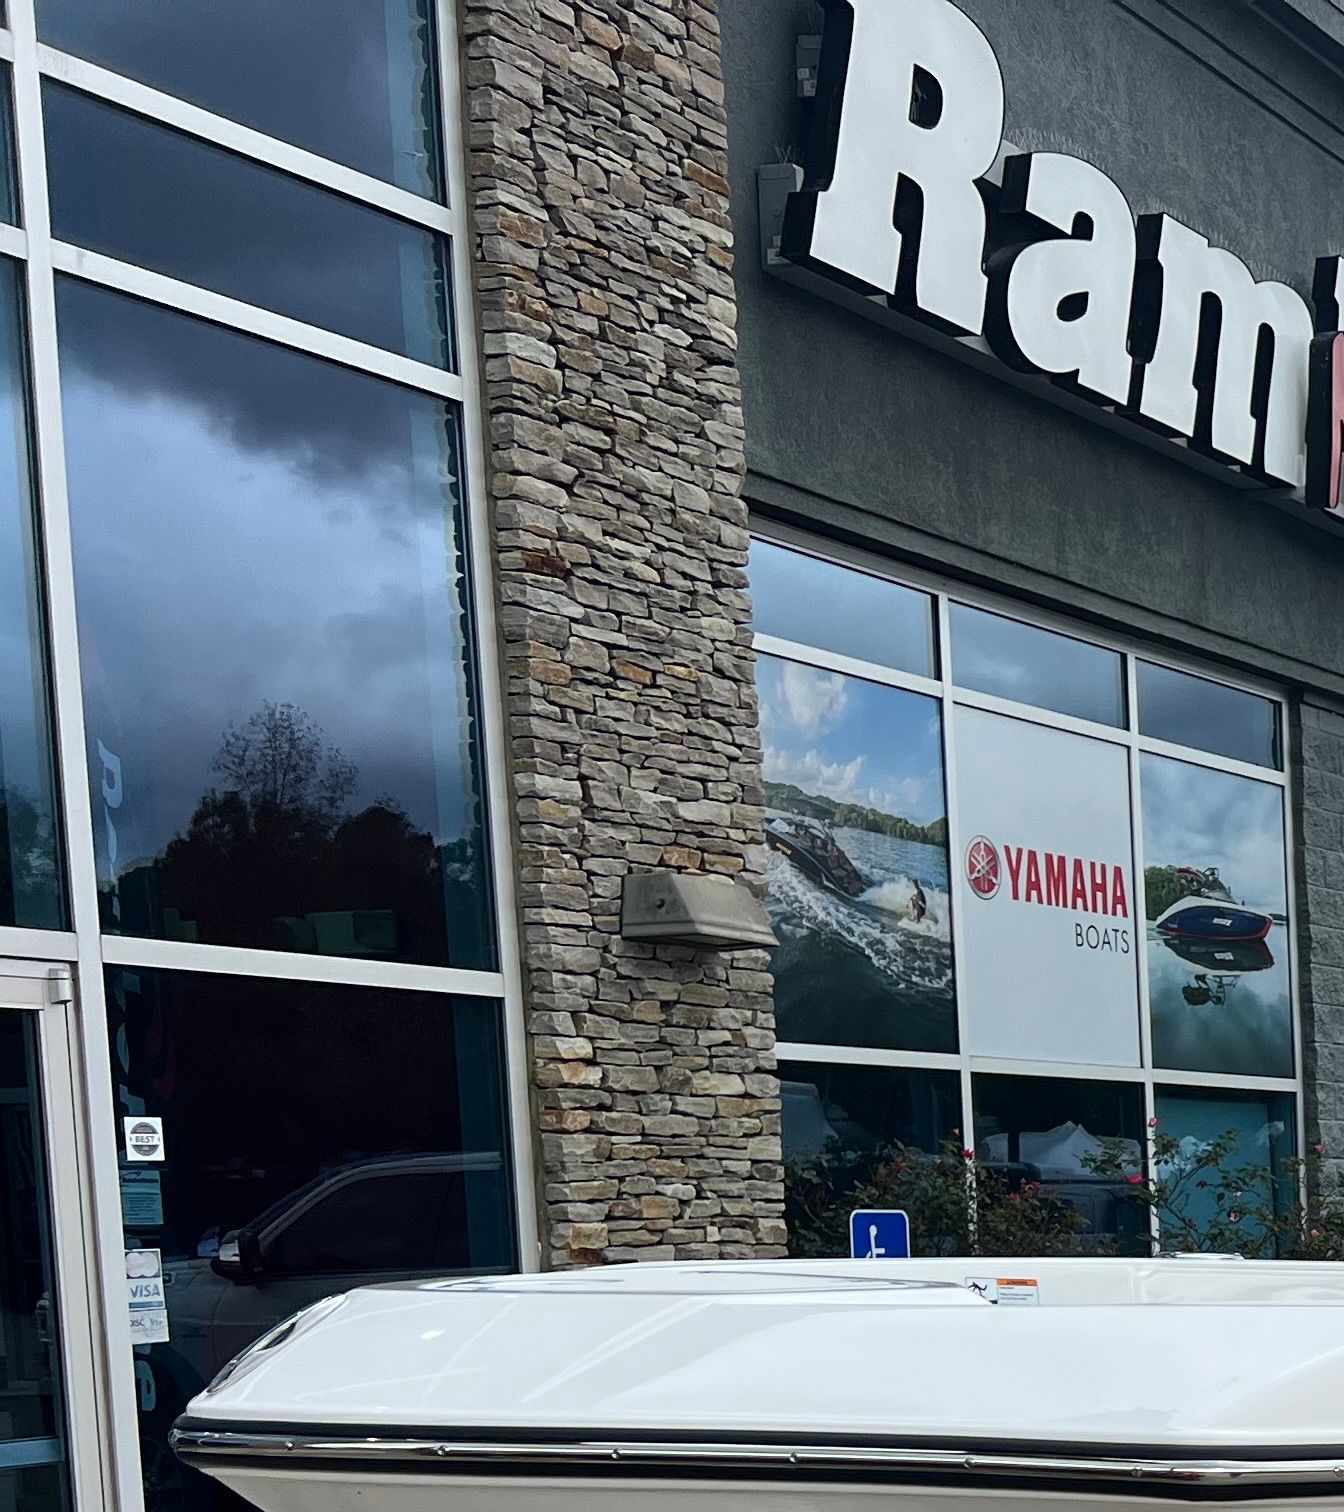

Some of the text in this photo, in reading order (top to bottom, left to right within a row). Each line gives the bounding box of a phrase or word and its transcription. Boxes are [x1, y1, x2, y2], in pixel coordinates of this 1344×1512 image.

[1003, 844, 1129, 918] YAMAHA
[1075, 923, 1130, 954] BOATS
[135, 1135, 155, 1144] BEST
[130, 1284, 161, 1298] VISA
